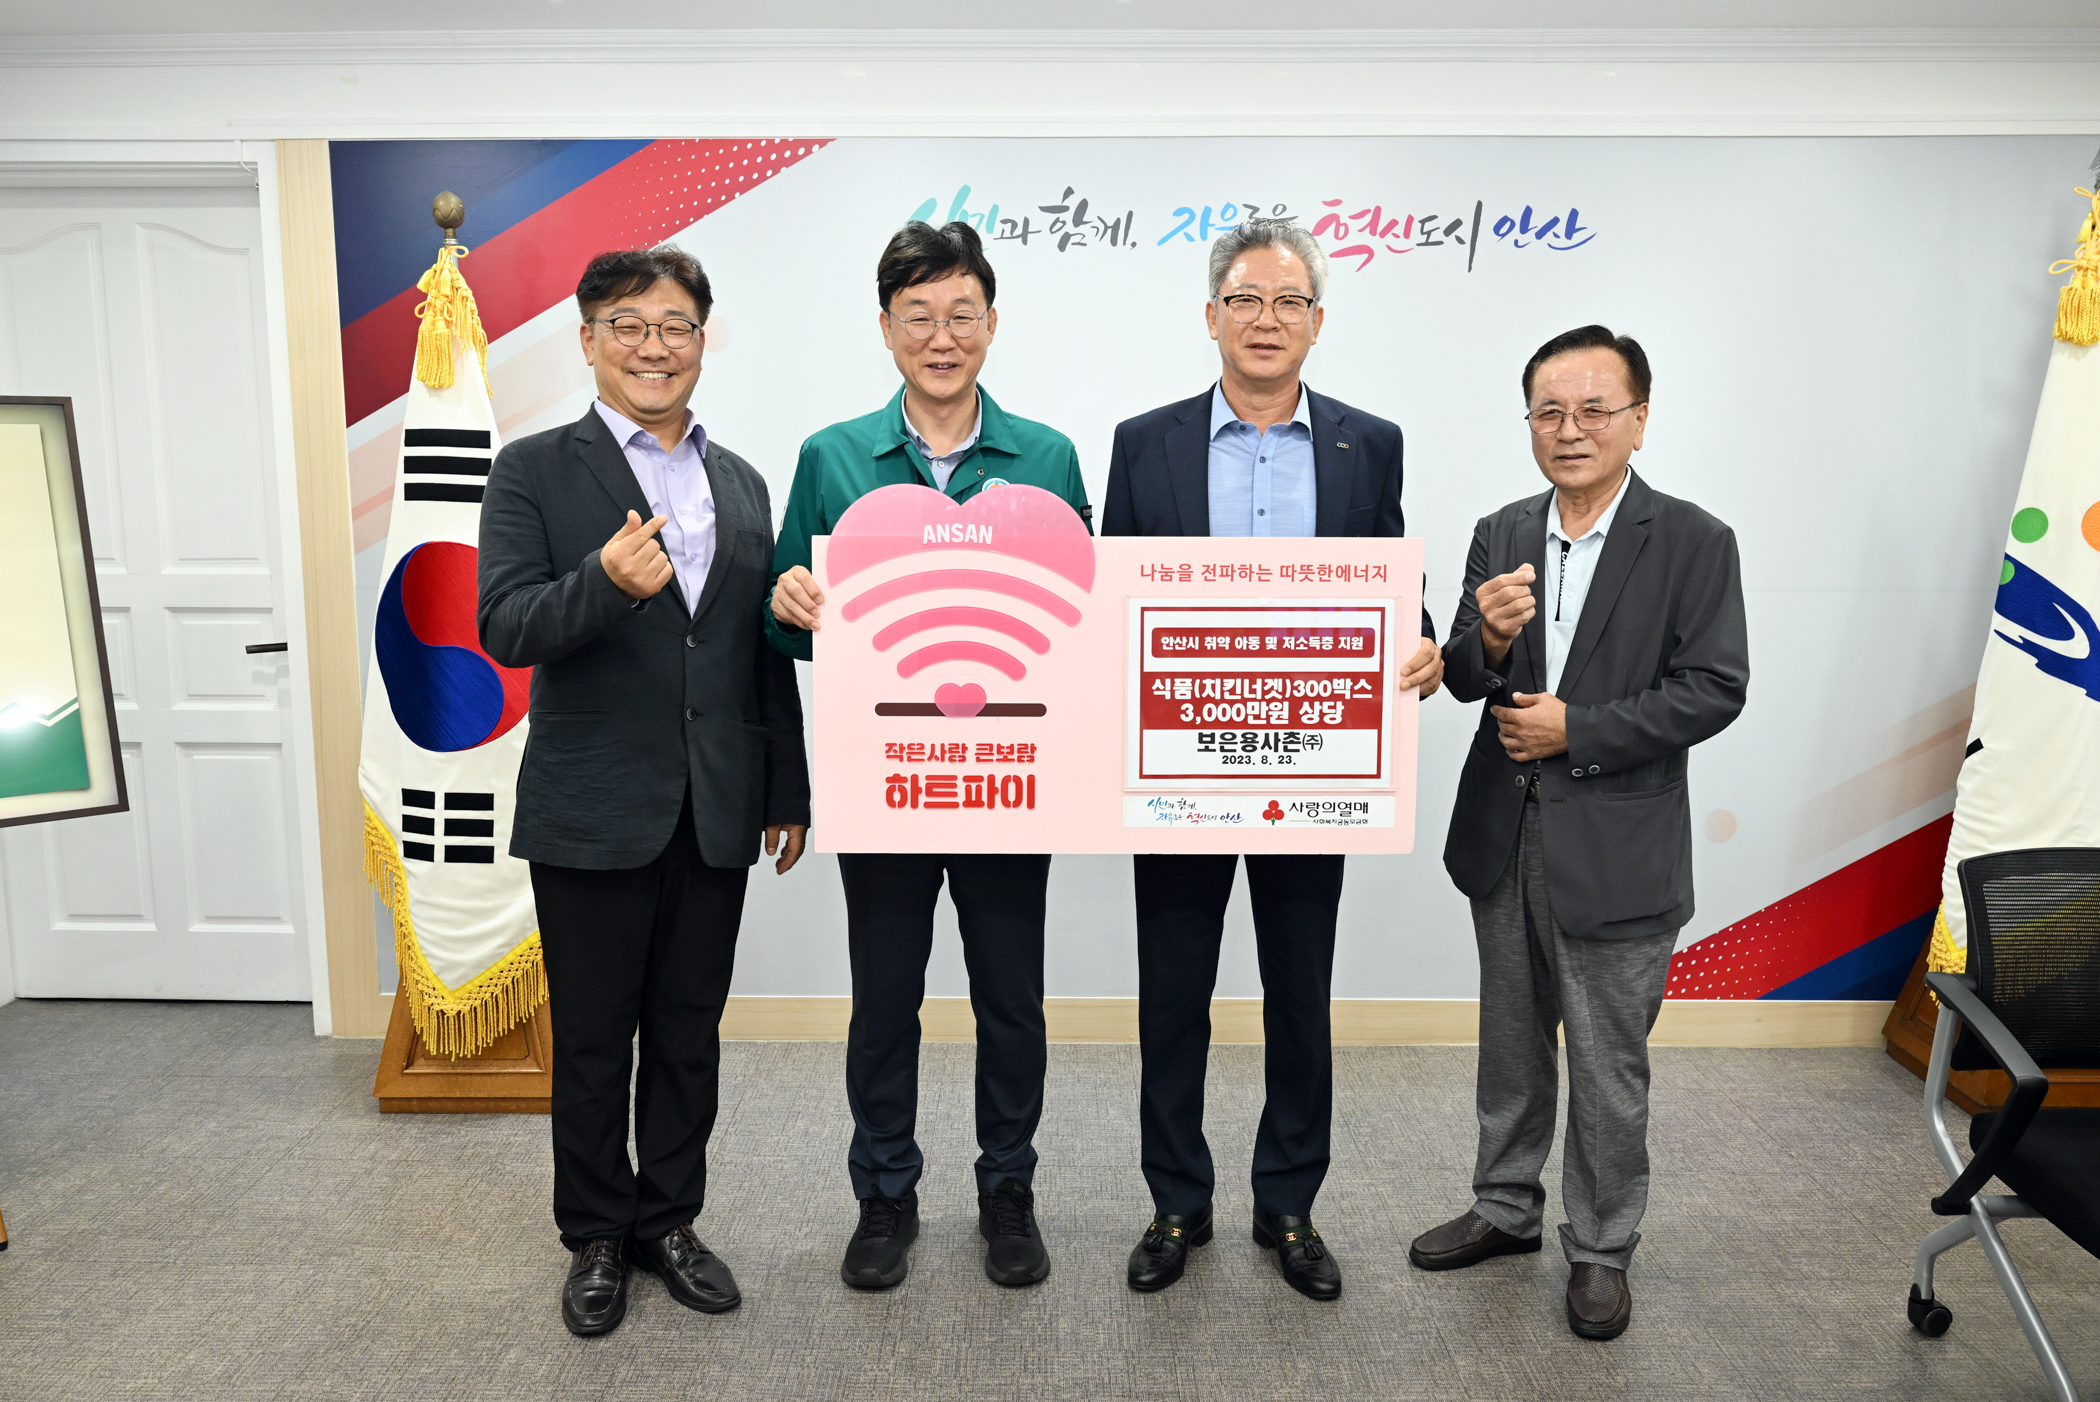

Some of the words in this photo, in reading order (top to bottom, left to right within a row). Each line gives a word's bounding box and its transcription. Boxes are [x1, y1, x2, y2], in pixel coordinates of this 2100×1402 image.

[1038, 186, 1138, 253] 함께,
[1312, 199, 1482, 273] 혁신도시
[1493, 205, 1598, 251] 안산
[922, 523, 994, 544] ANSAN
[1141, 564, 1193, 582] 나눔을
[1201, 564, 1273, 582] 전파하는
[1280, 564, 1387, 582] 따뜻한에너지
[1161, 636, 1199, 650] 안산시
[1204, 636, 1230, 650] 취약
[1235, 636, 1260, 650] 아동
[1265, 636, 1277, 650] 및
[1283, 636, 1334, 650] 저소득층
[1338, 636, 1363, 650] 지원
[1152, 678, 1372, 699] 식품(치킨너겟)300박스
[1180, 701, 1289, 724] 3,000만원
[1299, 701, 1344, 724] 상당
[885, 743, 968, 763] 작은사랑
[975, 743, 1037, 763] 큰보람
[1222, 755, 1255, 765] 2023.
[1261, 755, 1272, 765] 8.
[1278, 755, 1296, 765] 23.
[885, 773, 1035, 810] 하트파이
[1220, 813, 1243, 823] 안산
[1289, 802, 1368, 818] 사랑의열매
